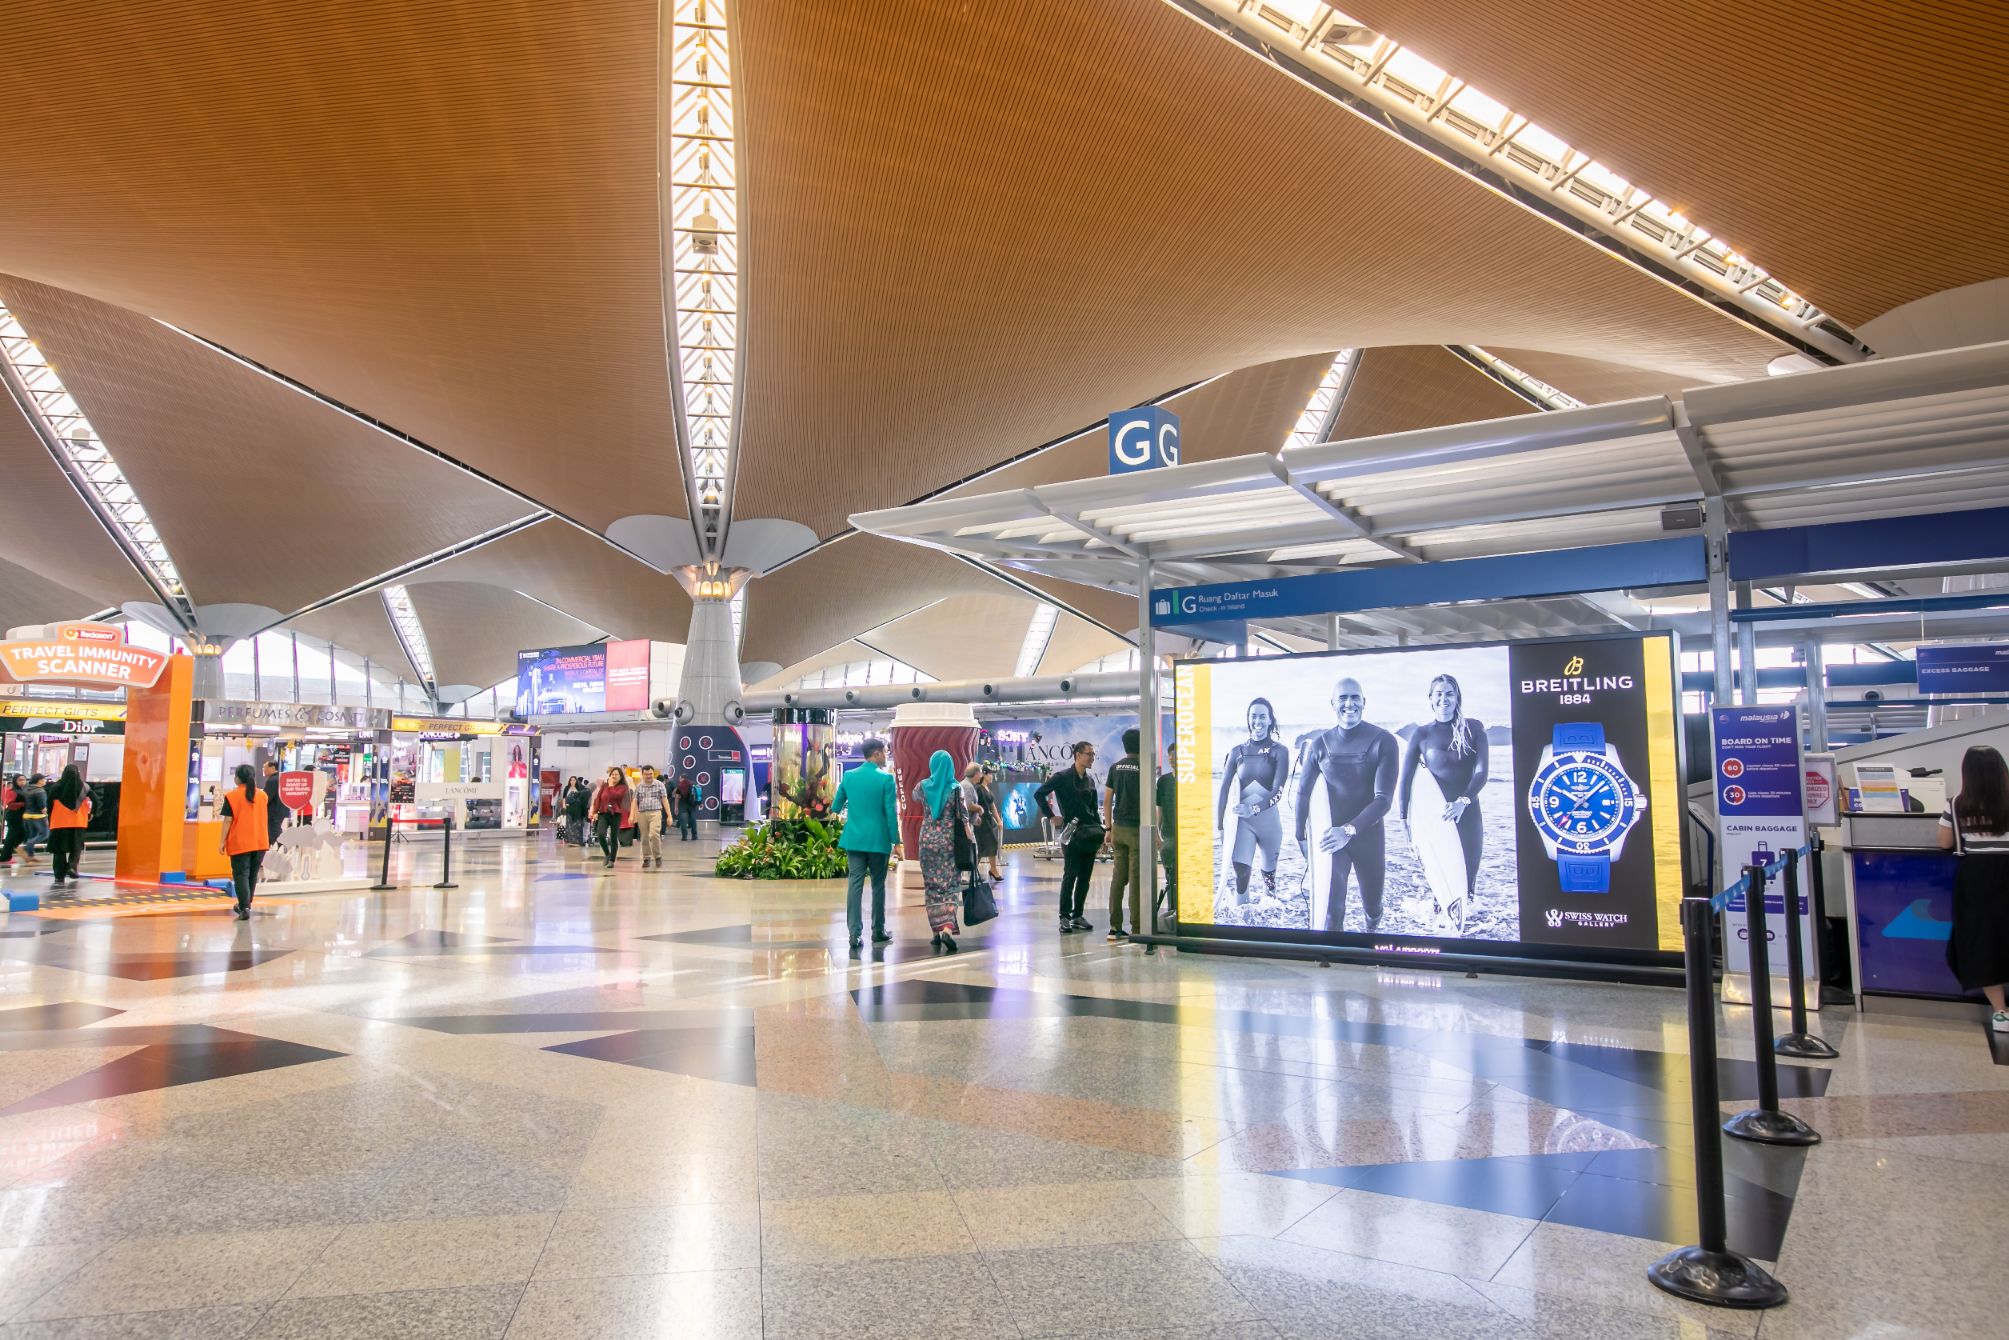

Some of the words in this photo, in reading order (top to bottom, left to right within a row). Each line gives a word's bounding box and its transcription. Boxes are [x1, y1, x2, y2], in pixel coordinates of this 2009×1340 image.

[1114, 420, 1150, 466] G
[1158, 423, 1178, 467] G
[1198, 595, 1222, 604] Ruang
[1223, 592, 1249, 601] Daftar
[1252, 588, 1279, 598] Masuk
[1182, 595, 1197, 614] G
[10, 645, 77, 660] TRAVEL
[79, 646, 157, 669] IMMUNITY
[37, 659, 131, 679] SCANNER
[1521, 676, 1634, 693] BREITLING
[1560, 694, 1591, 704] 1884
[2, 705, 59, 714] PERFECT
[64, 708, 98, 716] GIFTS
[219, 706, 290, 719] PERFUMES
[1740, 714, 1779, 722] malaysia
[62, 721, 98, 733] Dior
[428, 723, 462, 731] PERFECT
[1573, 771, 1588, 783] 12
[897, 768, 907, 810] COFFEE
[1549, 796, 1560, 808] 9
[1576, 821, 1587, 834] 6
[1564, 911, 1592, 920] SWISS
[1594, 913, 1628, 923] WATCH
